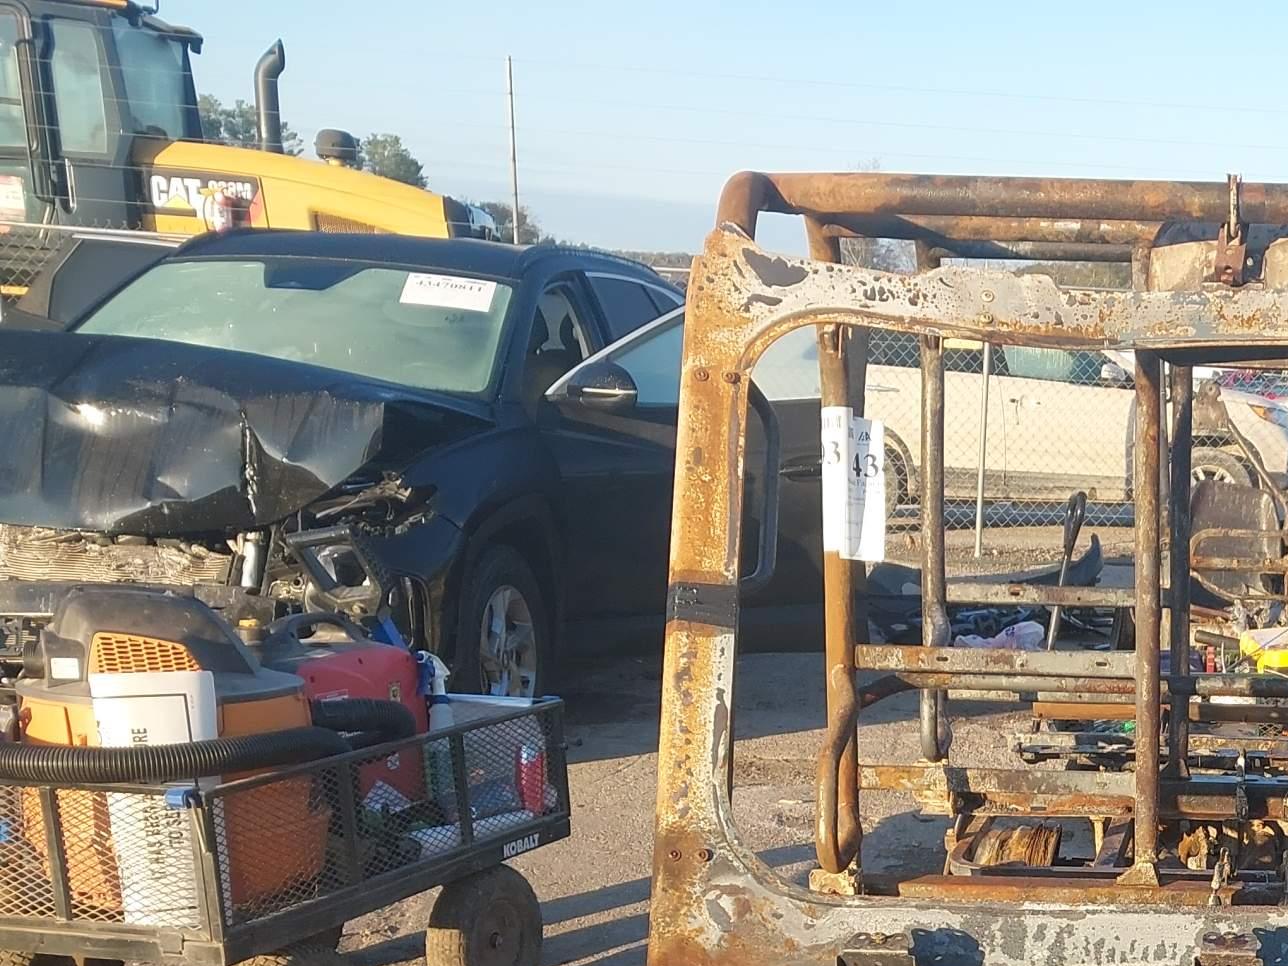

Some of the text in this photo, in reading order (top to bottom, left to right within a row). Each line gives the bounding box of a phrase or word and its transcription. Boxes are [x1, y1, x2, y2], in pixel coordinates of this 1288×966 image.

[150, 175, 201, 212] CAT
[852, 452, 885, 478] 43
[503, 833, 539, 858] KOBALT
